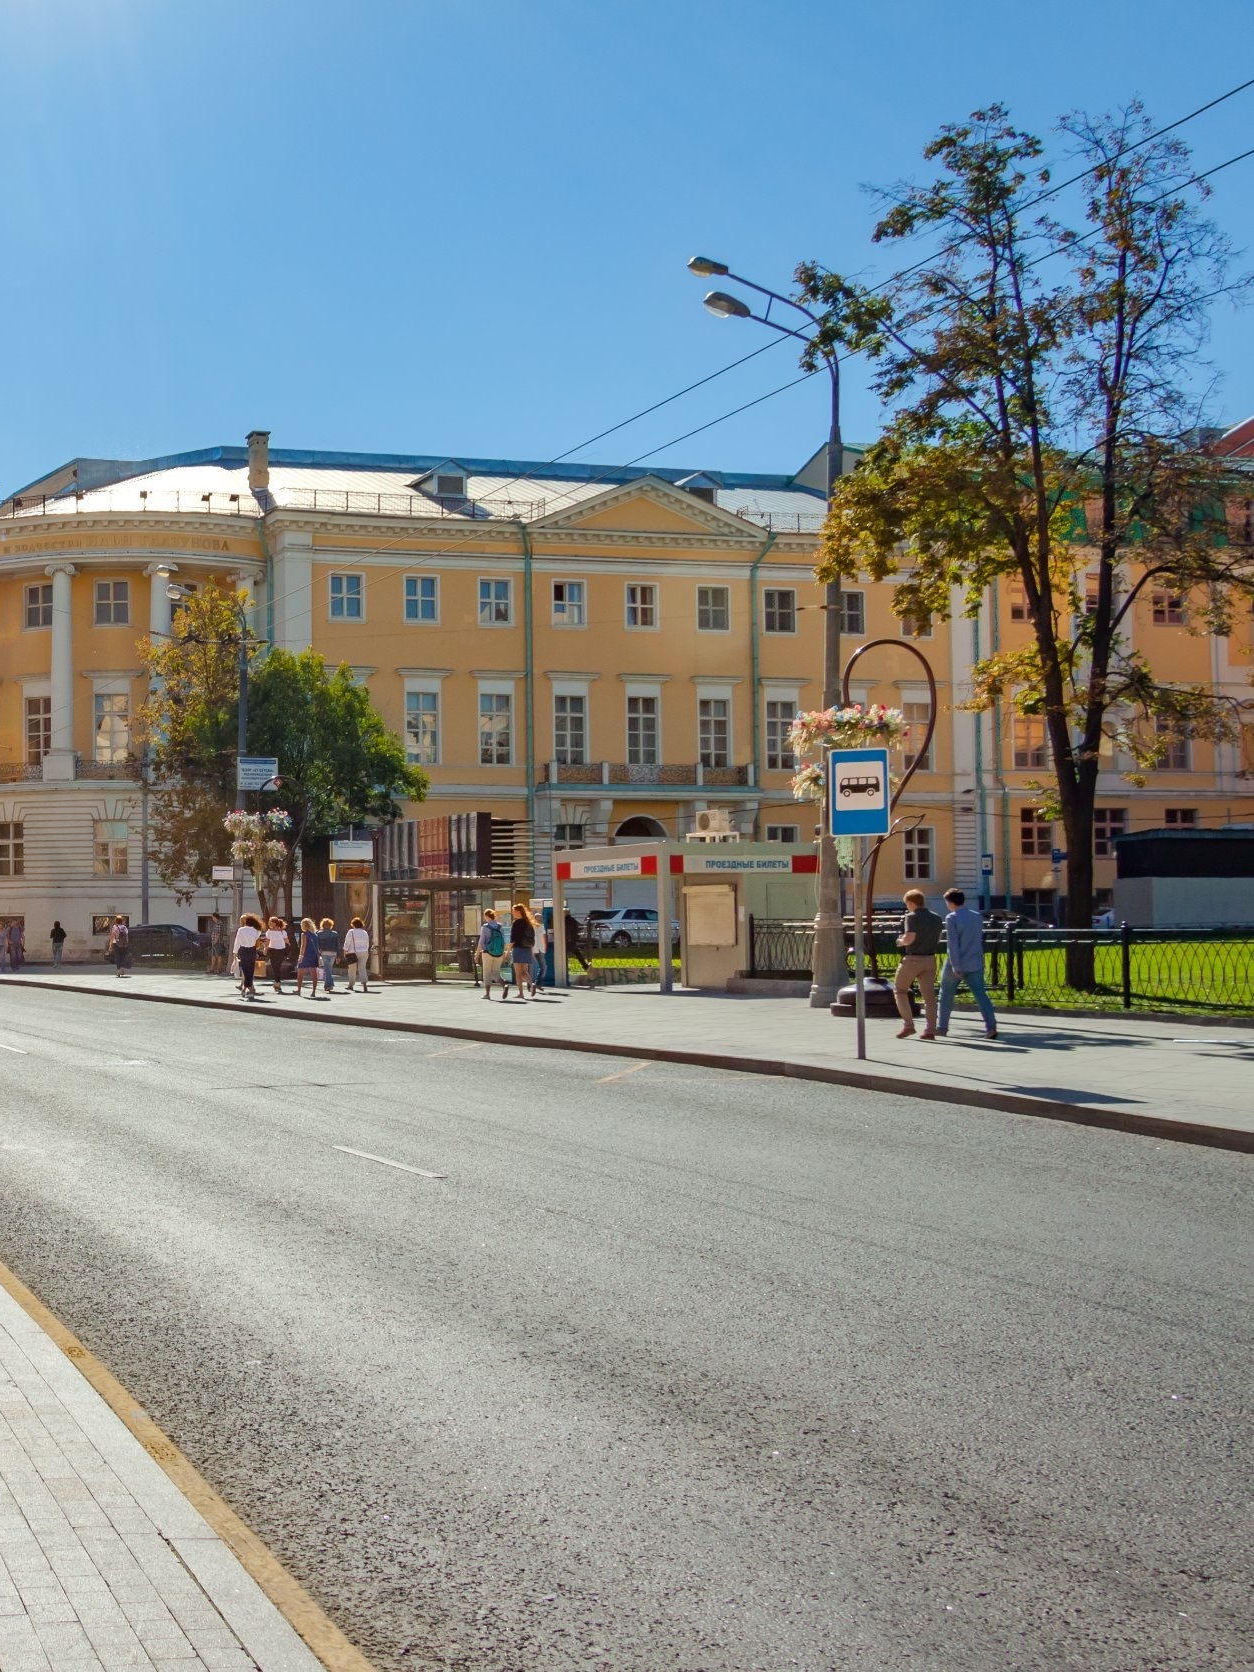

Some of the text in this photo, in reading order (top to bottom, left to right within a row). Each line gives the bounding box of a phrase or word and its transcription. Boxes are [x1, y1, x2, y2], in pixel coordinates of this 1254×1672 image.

[584, 862, 639, 873] ПРОЕЗДНЫЕ БИЛЕТЫ
[705, 860, 789, 870] ПРОЕЗДНЫЕ БИЛЕТЫ
